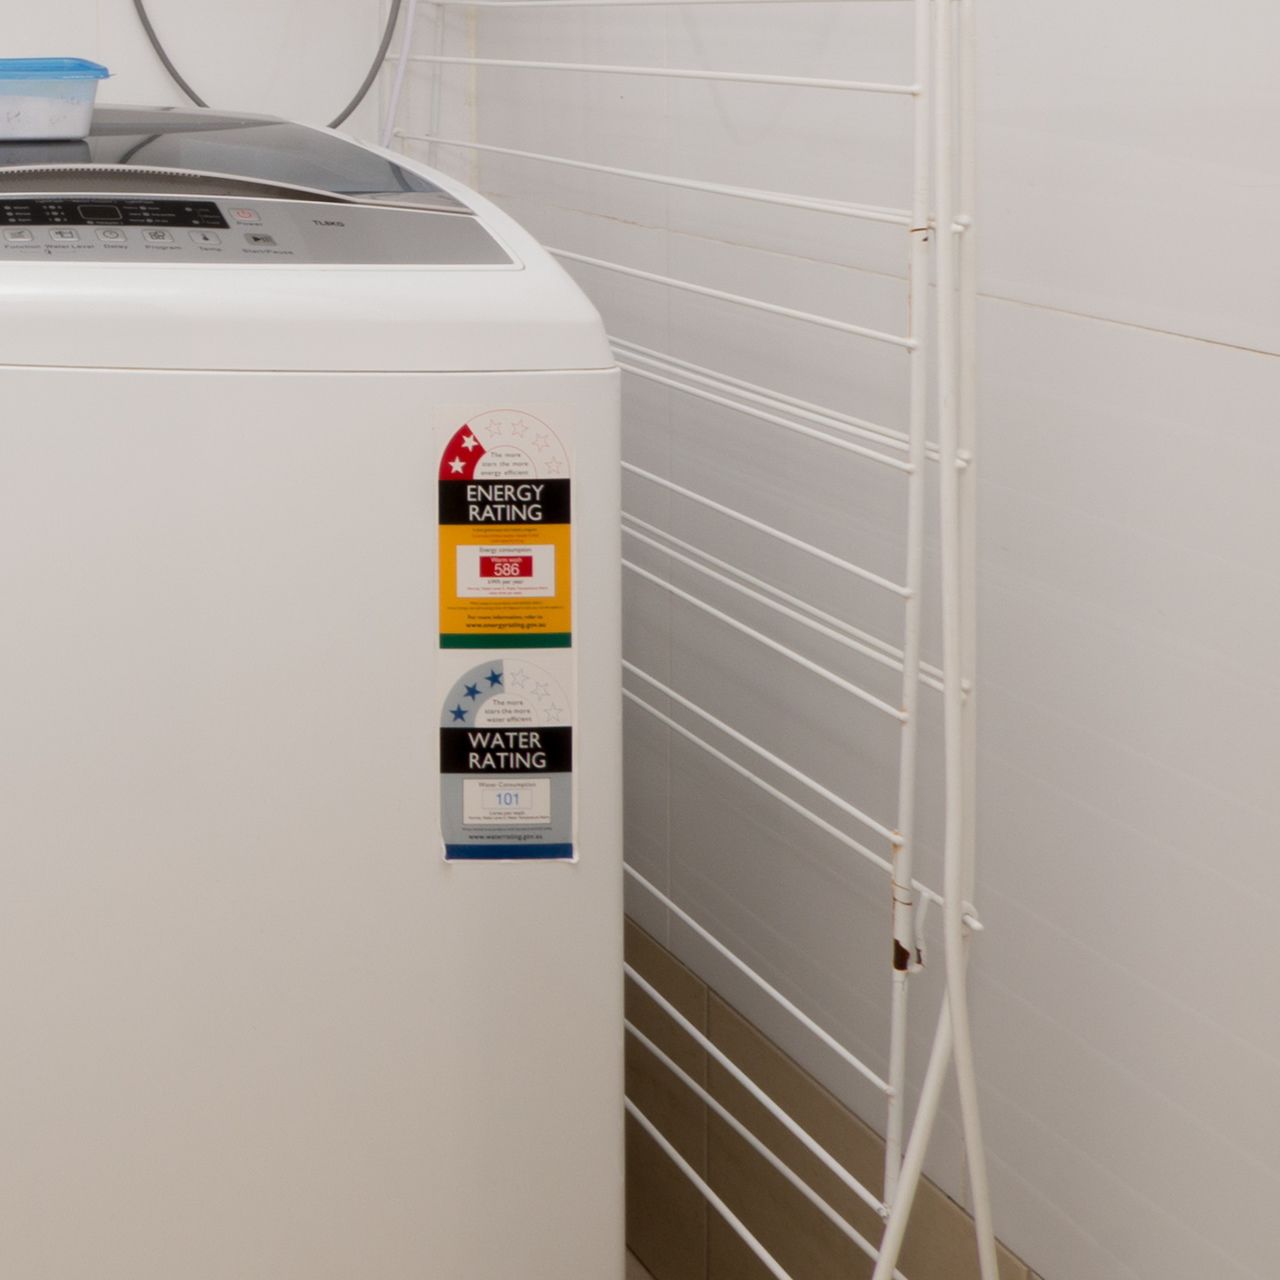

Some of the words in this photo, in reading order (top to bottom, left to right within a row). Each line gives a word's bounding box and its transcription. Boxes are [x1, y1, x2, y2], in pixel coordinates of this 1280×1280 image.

[466, 485, 545, 502] ENERGY
[469, 504, 543, 521] RATING
[493, 563, 520, 576] 586
[468, 732, 542, 749] WATER
[469, 752, 546, 769] RATING
[496, 793, 519, 805] 101
